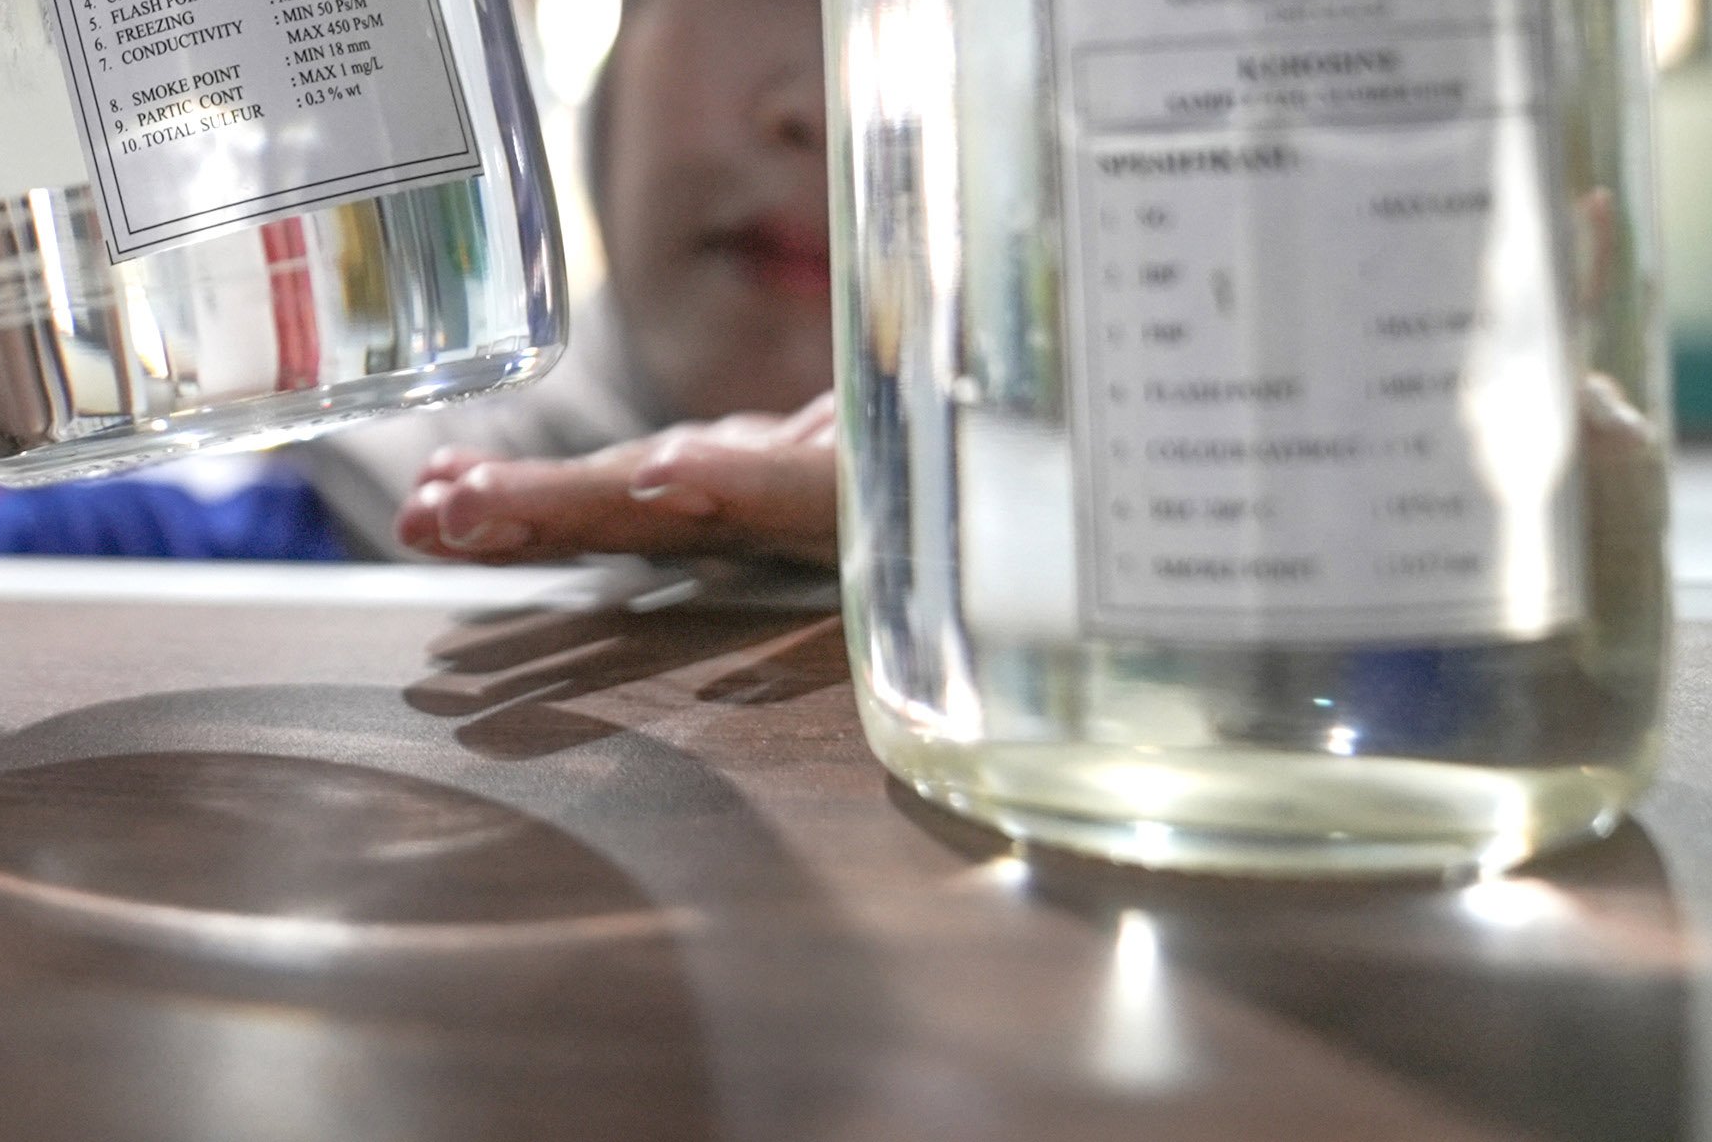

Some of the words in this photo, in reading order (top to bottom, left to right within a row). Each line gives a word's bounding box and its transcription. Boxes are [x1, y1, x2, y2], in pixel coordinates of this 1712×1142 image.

[89, 16, 101, 31] 5.
[94, 37, 107, 51] 6.
[115, 10, 194, 44] FREEZING
[98, 57, 112, 72] 7.
[121, 19, 242, 64] CONDUCTIVITY
[281, 4, 314, 23] MIN
[317, 0, 333, 16] 50
[286, 24, 324, 44] MAX
[327, 18, 350, 35] 450
[352, 12, 384, 31] Ps/M
[109, 98, 122, 113] 8.
[131, 78, 190, 106] SMOKE
[192, 64, 240, 89] POINT
[293, 45, 324, 64] MIN
[328, 41, 344, 56] 18
[346, 40, 371, 53] mm
[114, 119, 128, 134] 9.
[136, 99, 191, 127] PARTIC
[199, 85, 243, 109] CONT
[298, 64, 337, 85] MAX
[340, 62, 347, 76] 1
[350, 56, 383, 76] mg/L
[121, 138, 141, 154] 10.
[141, 123, 195, 147] TOTAL
[200, 103, 264, 131] SULFUR
[304, 89, 325, 106] 0.3
[327, 85, 343, 101] %
[344, 83, 361, 96] wt
